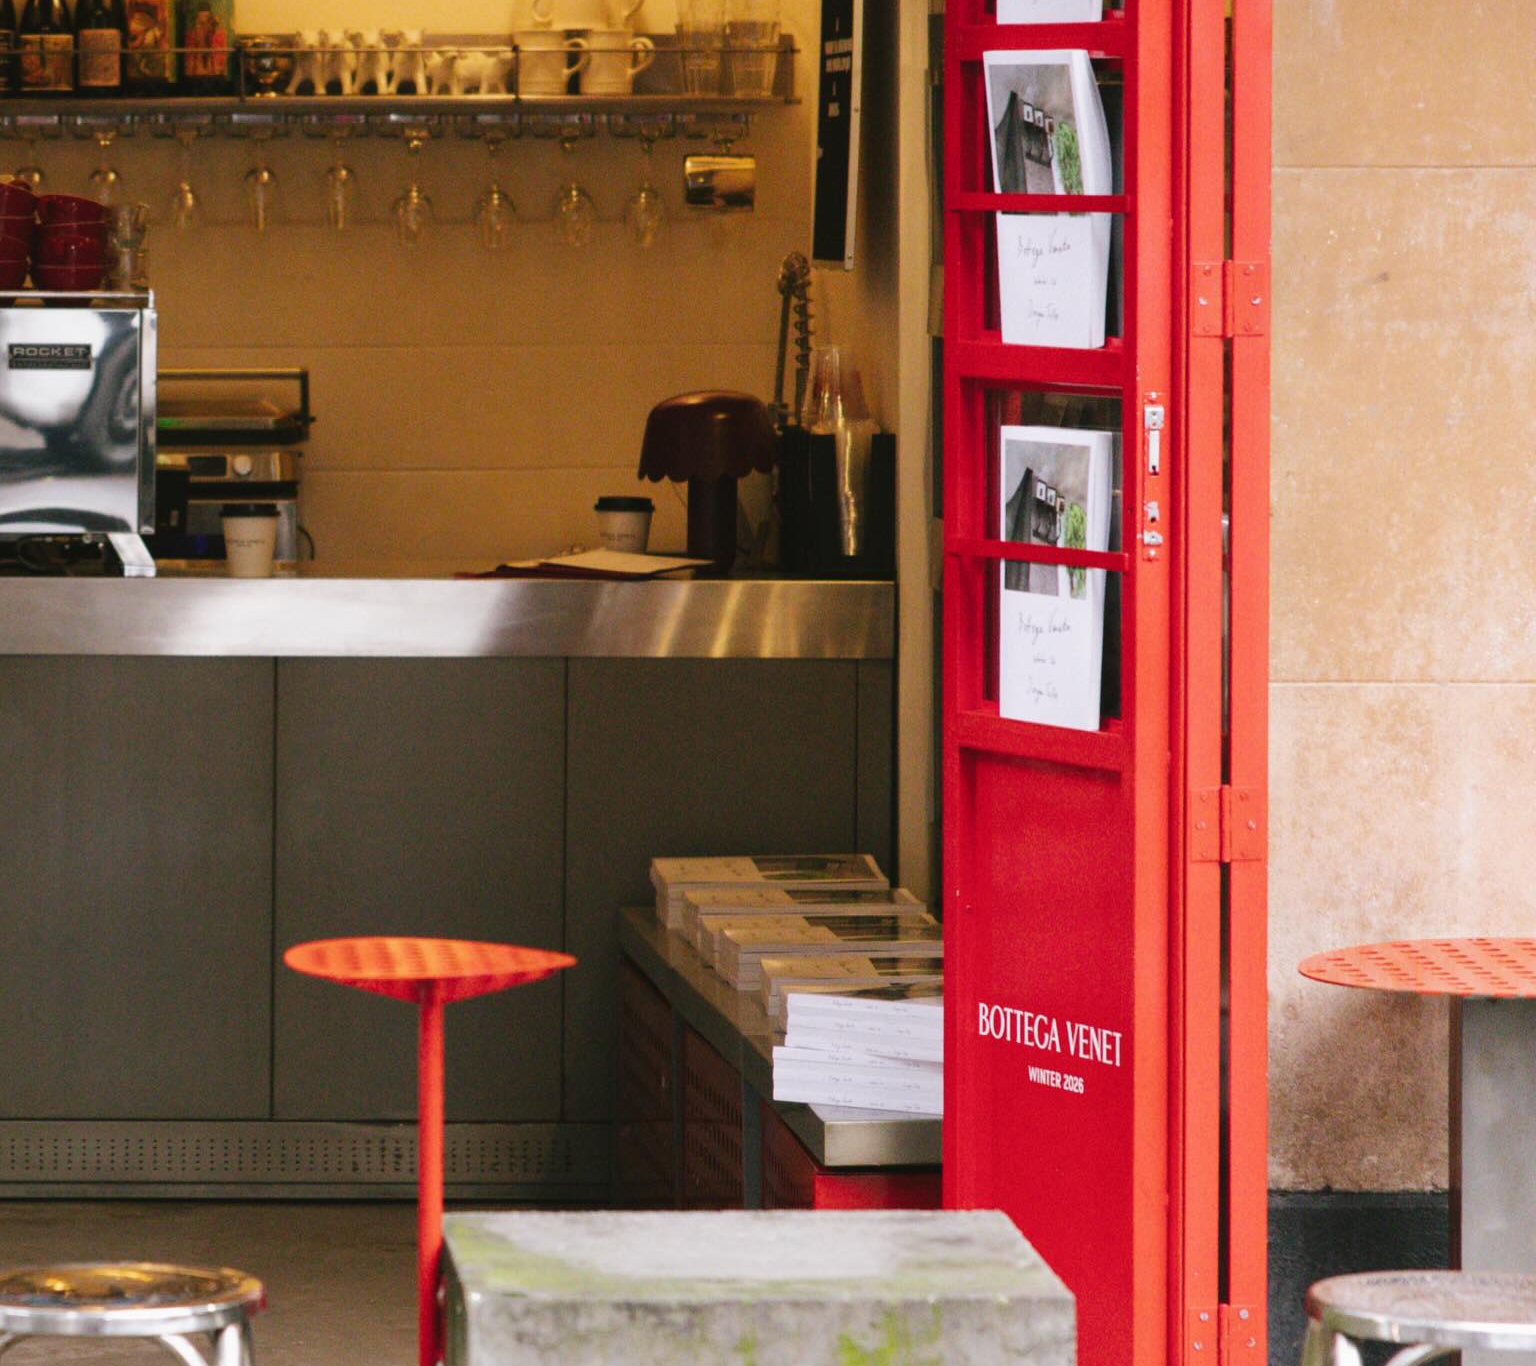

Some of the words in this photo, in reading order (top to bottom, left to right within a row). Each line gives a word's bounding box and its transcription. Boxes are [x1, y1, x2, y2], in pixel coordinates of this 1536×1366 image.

[13, 346, 88, 356] ROCKET
[978, 1002, 1062, 1053] BOTTEGA
[1028, 1066, 1063, 1089] WINTER
[1064, 1073, 1085, 1095] 2026
